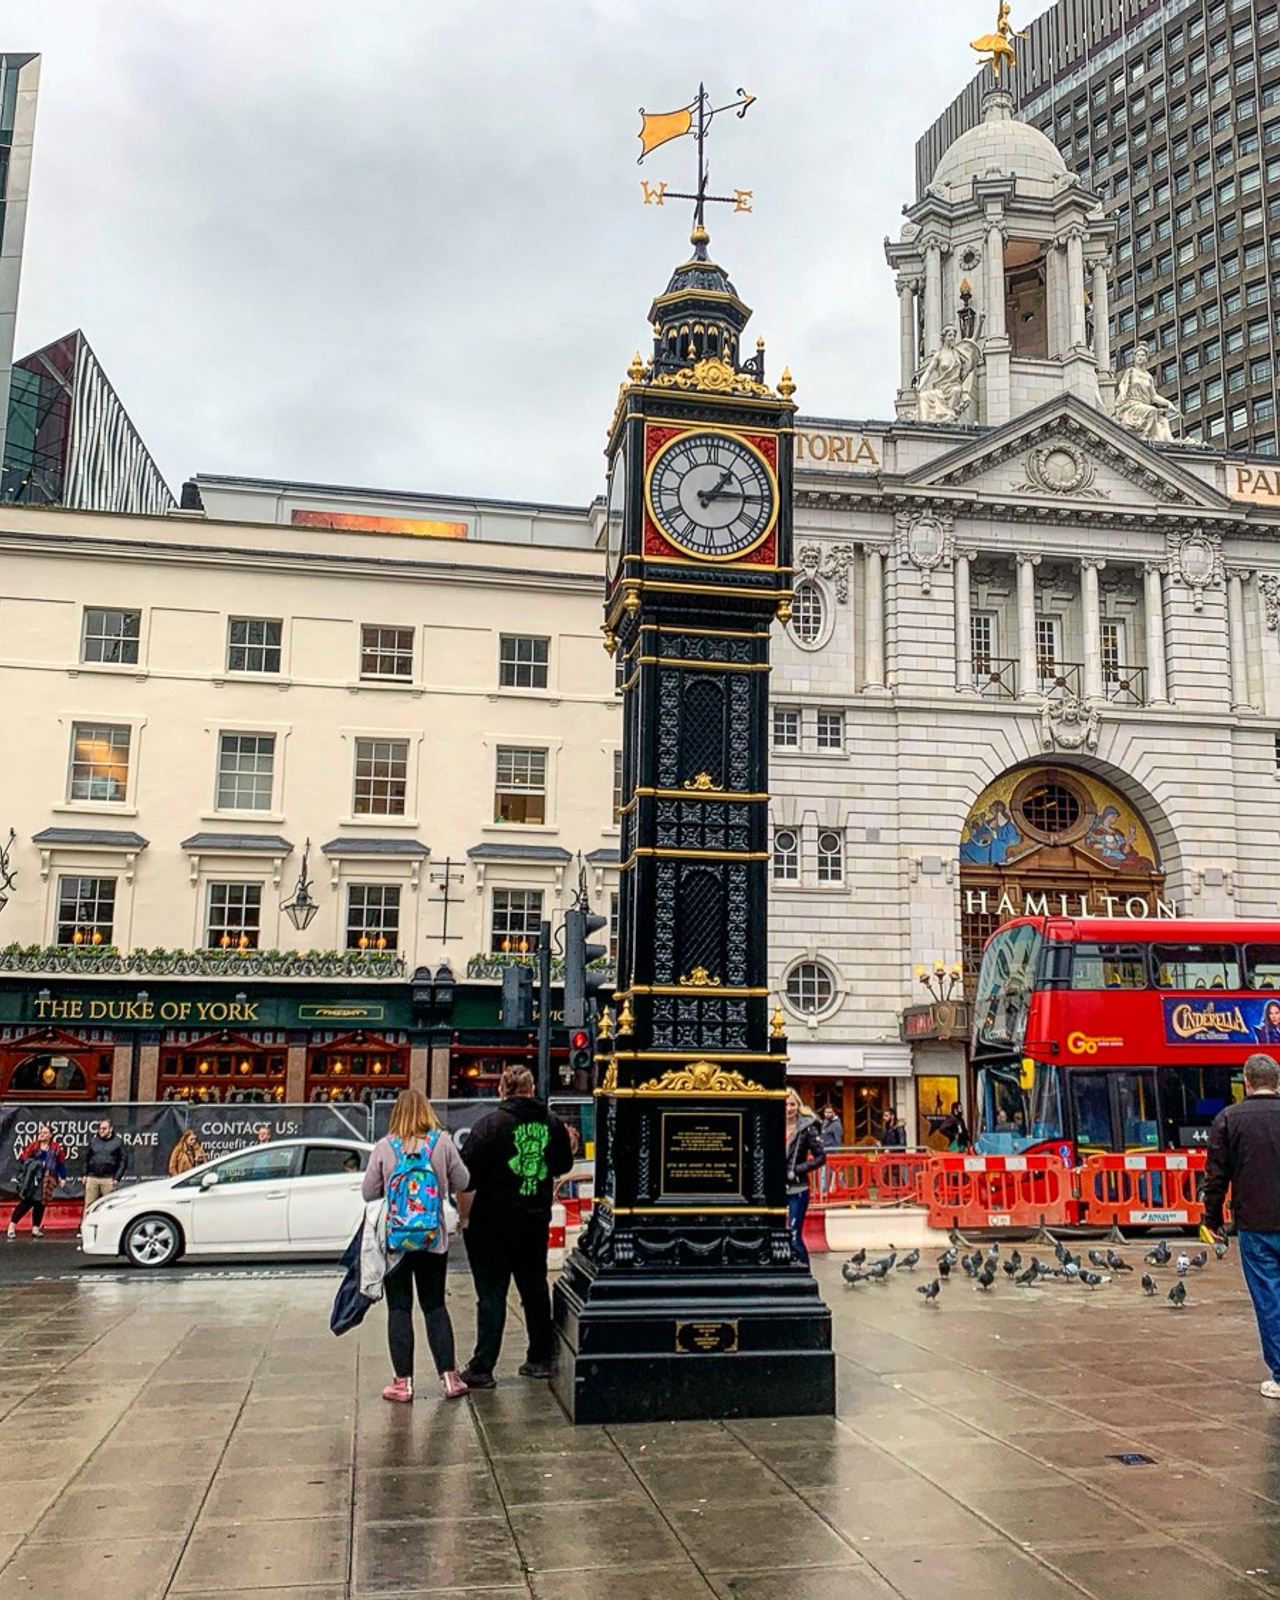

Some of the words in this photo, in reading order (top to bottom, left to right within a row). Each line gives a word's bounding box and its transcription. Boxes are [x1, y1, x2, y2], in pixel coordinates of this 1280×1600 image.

[1235, 468, 1280, 495] PA
[964, 890, 1178, 919] HAMILTON
[35, 1000, 83, 1019] THE
[89, 1000, 155, 1019] DUKE
[160, 1001, 191, 1019] OF
[197, 1002, 259, 1021] YORK
[1172, 1004, 1250, 1038] CINDERELLA
[14, 1121, 102, 1134] CONSTRUC
